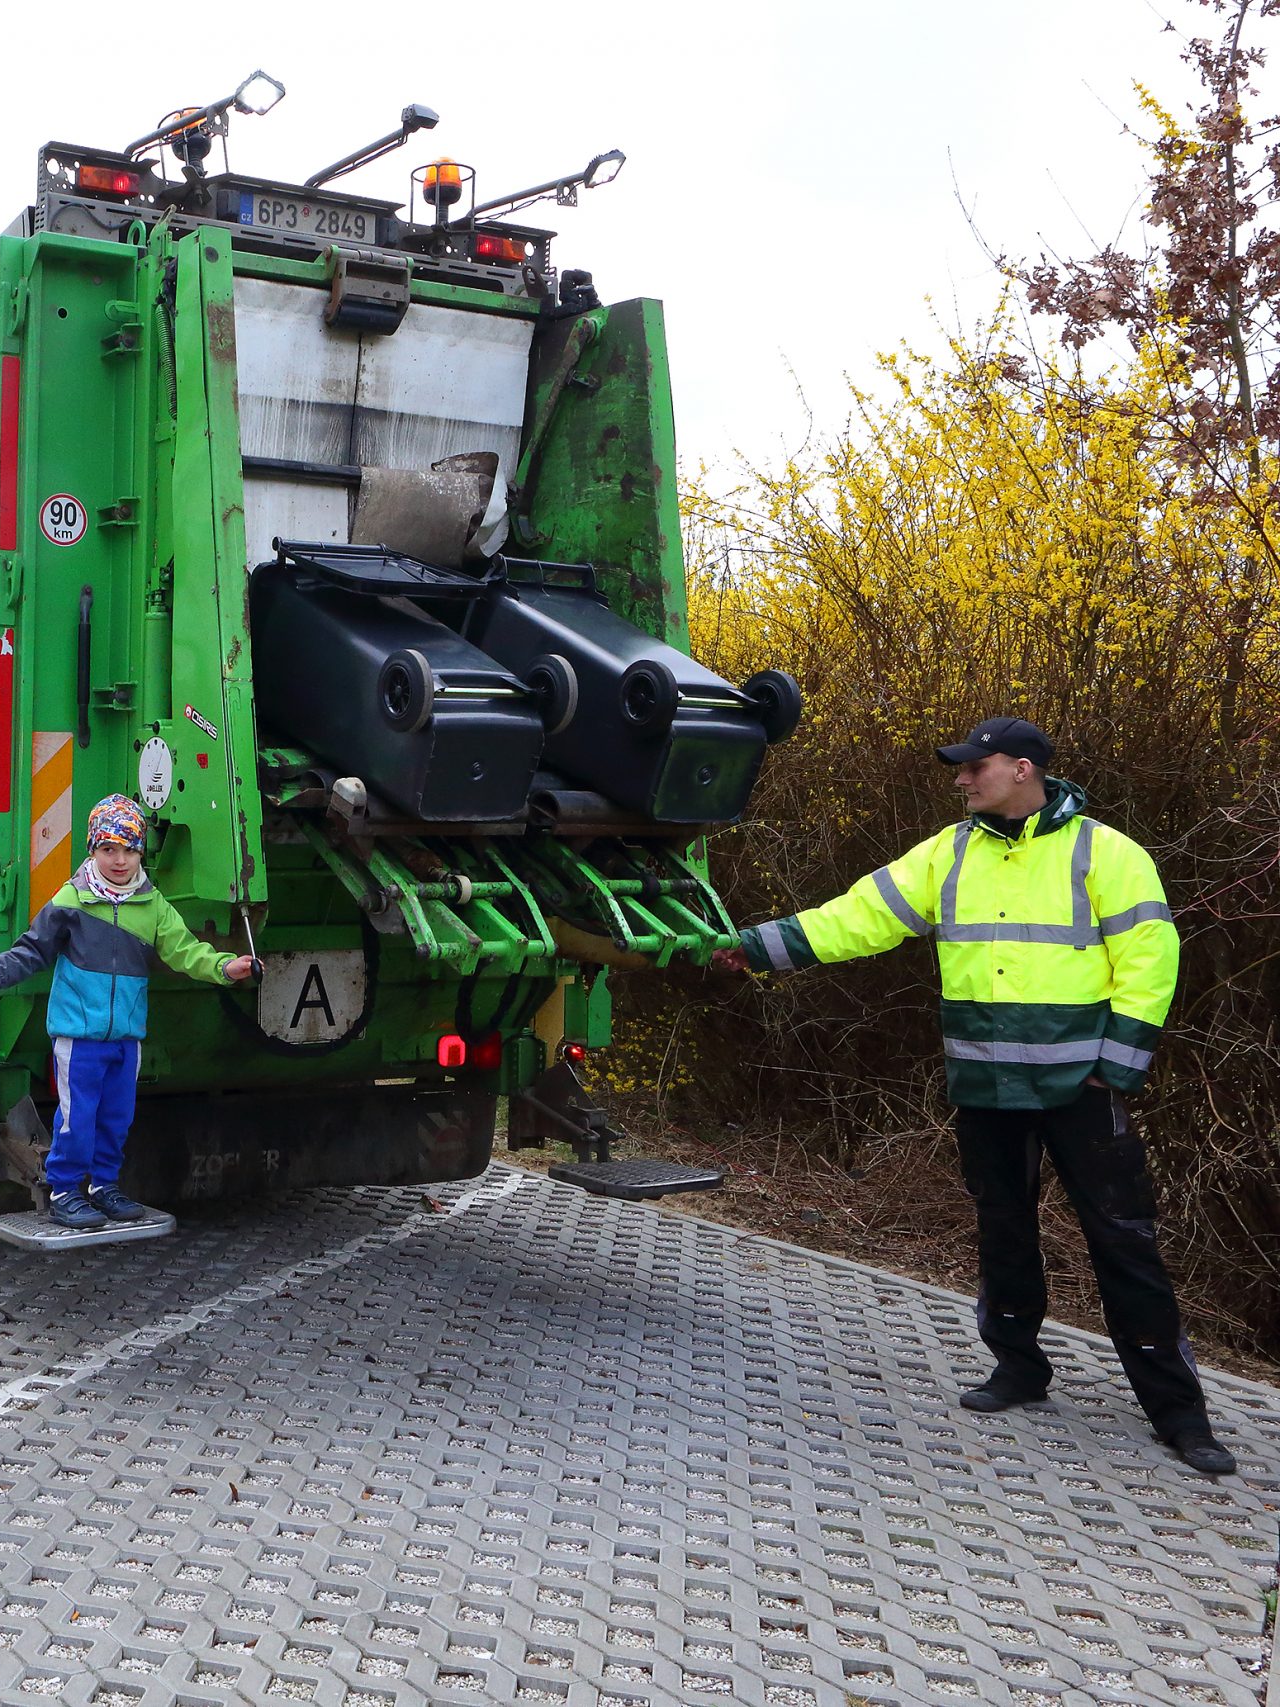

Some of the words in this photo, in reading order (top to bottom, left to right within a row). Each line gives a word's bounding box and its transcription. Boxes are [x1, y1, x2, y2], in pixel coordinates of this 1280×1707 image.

[241, 213, 252, 222] CZ
[258, 198, 298, 229] 6P3
[314, 208, 366, 240] 2849
[50, 500, 77, 527] 90
[54, 527, 73, 539] km
[289, 963, 336, 1029] A
